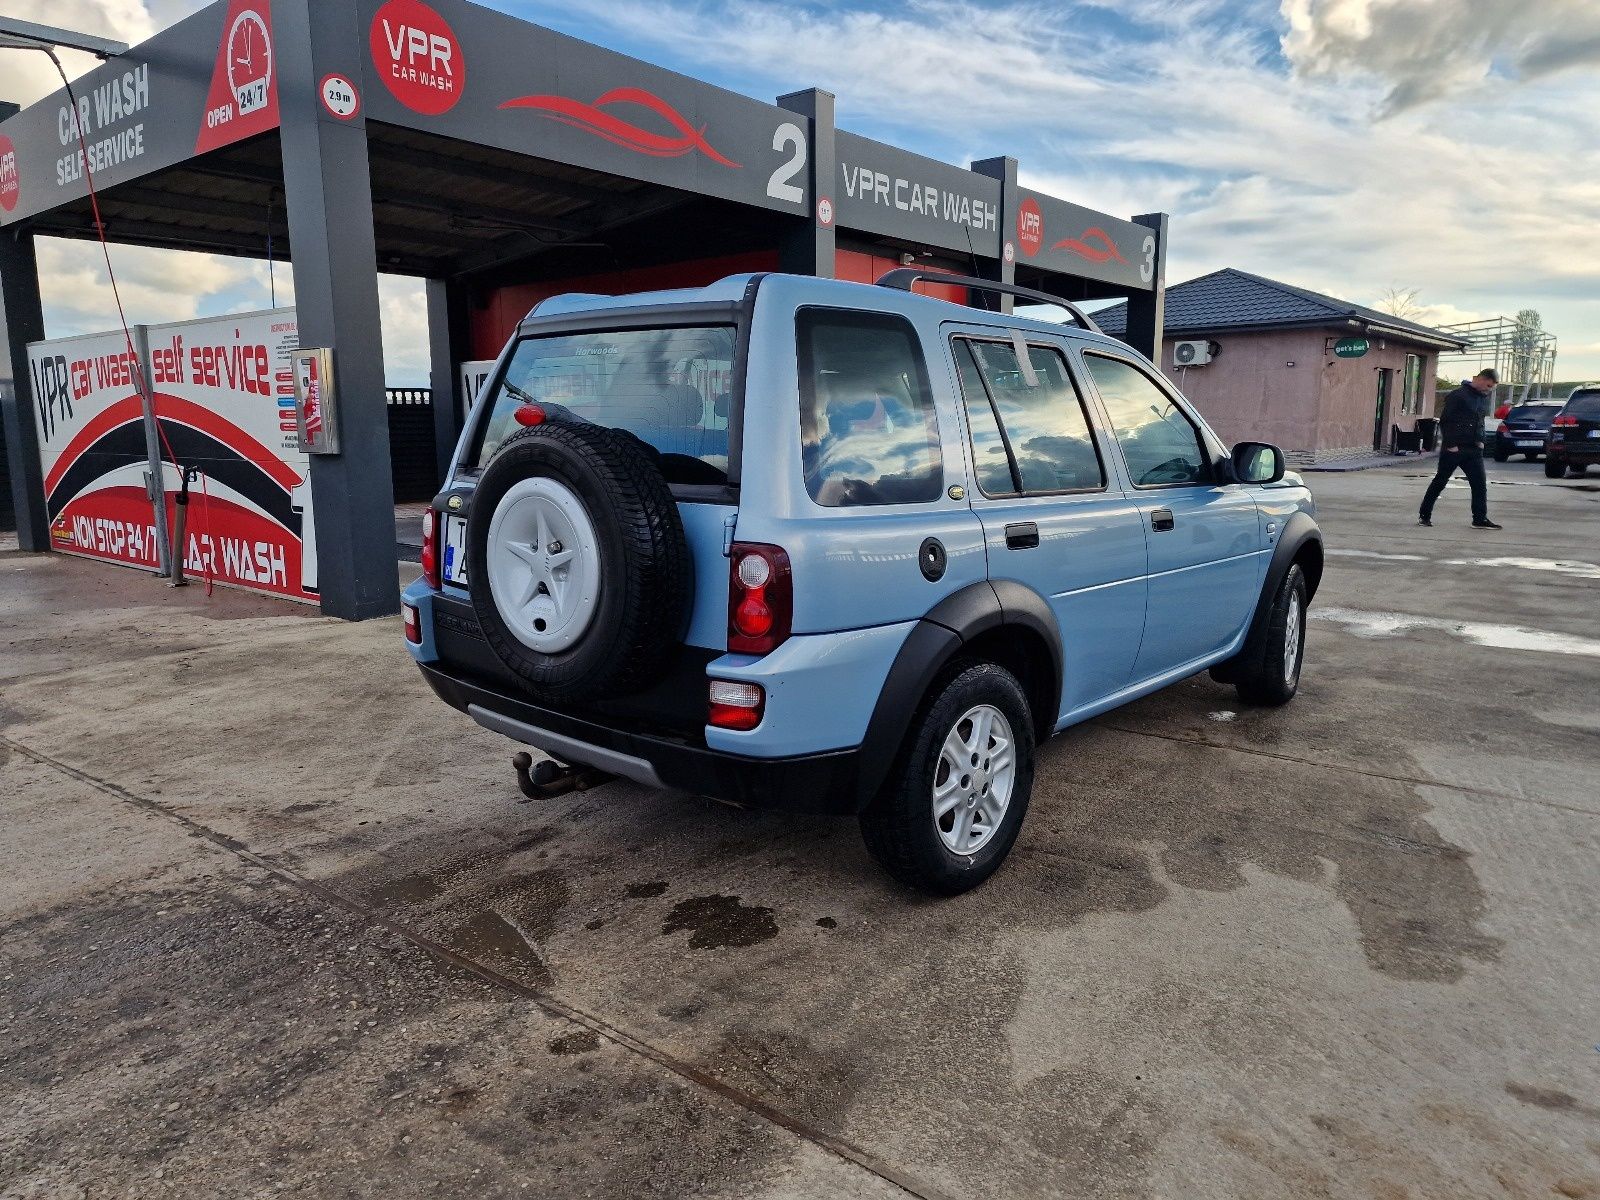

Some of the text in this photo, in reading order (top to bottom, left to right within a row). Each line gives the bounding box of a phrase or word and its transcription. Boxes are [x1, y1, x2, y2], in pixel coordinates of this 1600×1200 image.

[382, 18, 453, 76] VPR
[58, 62, 149, 146] CAR WASH
[239, 84, 264, 109] 24/7
[329, 89, 351, 103] 2.9 m
[392, 63, 453, 93] CAR WASH
[207, 103, 233, 129] OPEN
[56, 123, 145, 186] SELF SERVICE
[766, 122, 807, 204] 2
[842, 162, 997, 232] VPR CAR WASH
[1020, 210, 1040, 235] VPR
[1139, 235, 1156, 283] 3
[31, 354, 74, 443] VPR
[70, 358, 93, 401] car
[152, 334, 184, 384] self
[190, 328, 271, 397] service
[72, 514, 288, 588] NON STOP 24/7 AR WASH
